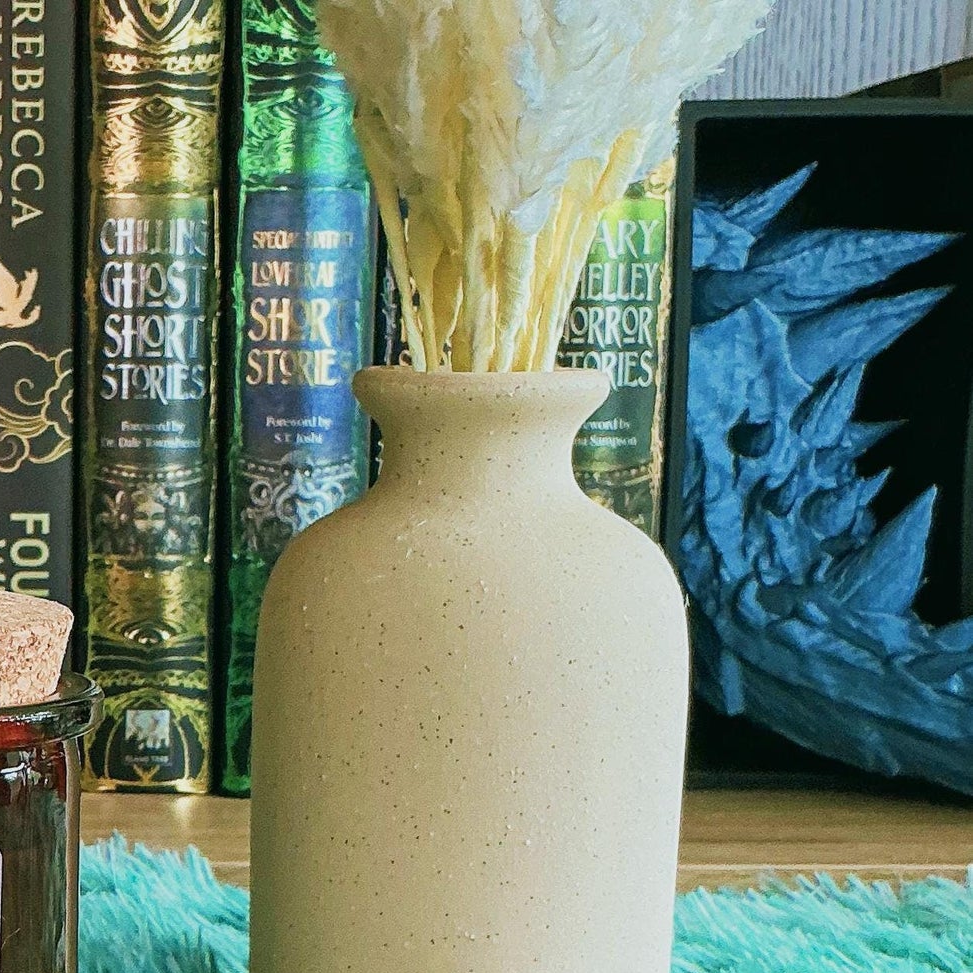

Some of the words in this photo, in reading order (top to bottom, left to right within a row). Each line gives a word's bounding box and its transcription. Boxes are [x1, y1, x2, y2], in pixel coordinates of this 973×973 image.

[11, 0, 45, 229] REBECCA
[100, 217, 208, 255] CHILLING
[592, 219, 660, 260] ARY
[100, 260, 208, 309] GHOST
[579, 262, 659, 301] ELLEY
[103, 314, 207, 364] SHORT
[100, 363, 208, 405] STORIES
[583, 417, 619, 430] eword
[9, 512, 51, 597] FOU
